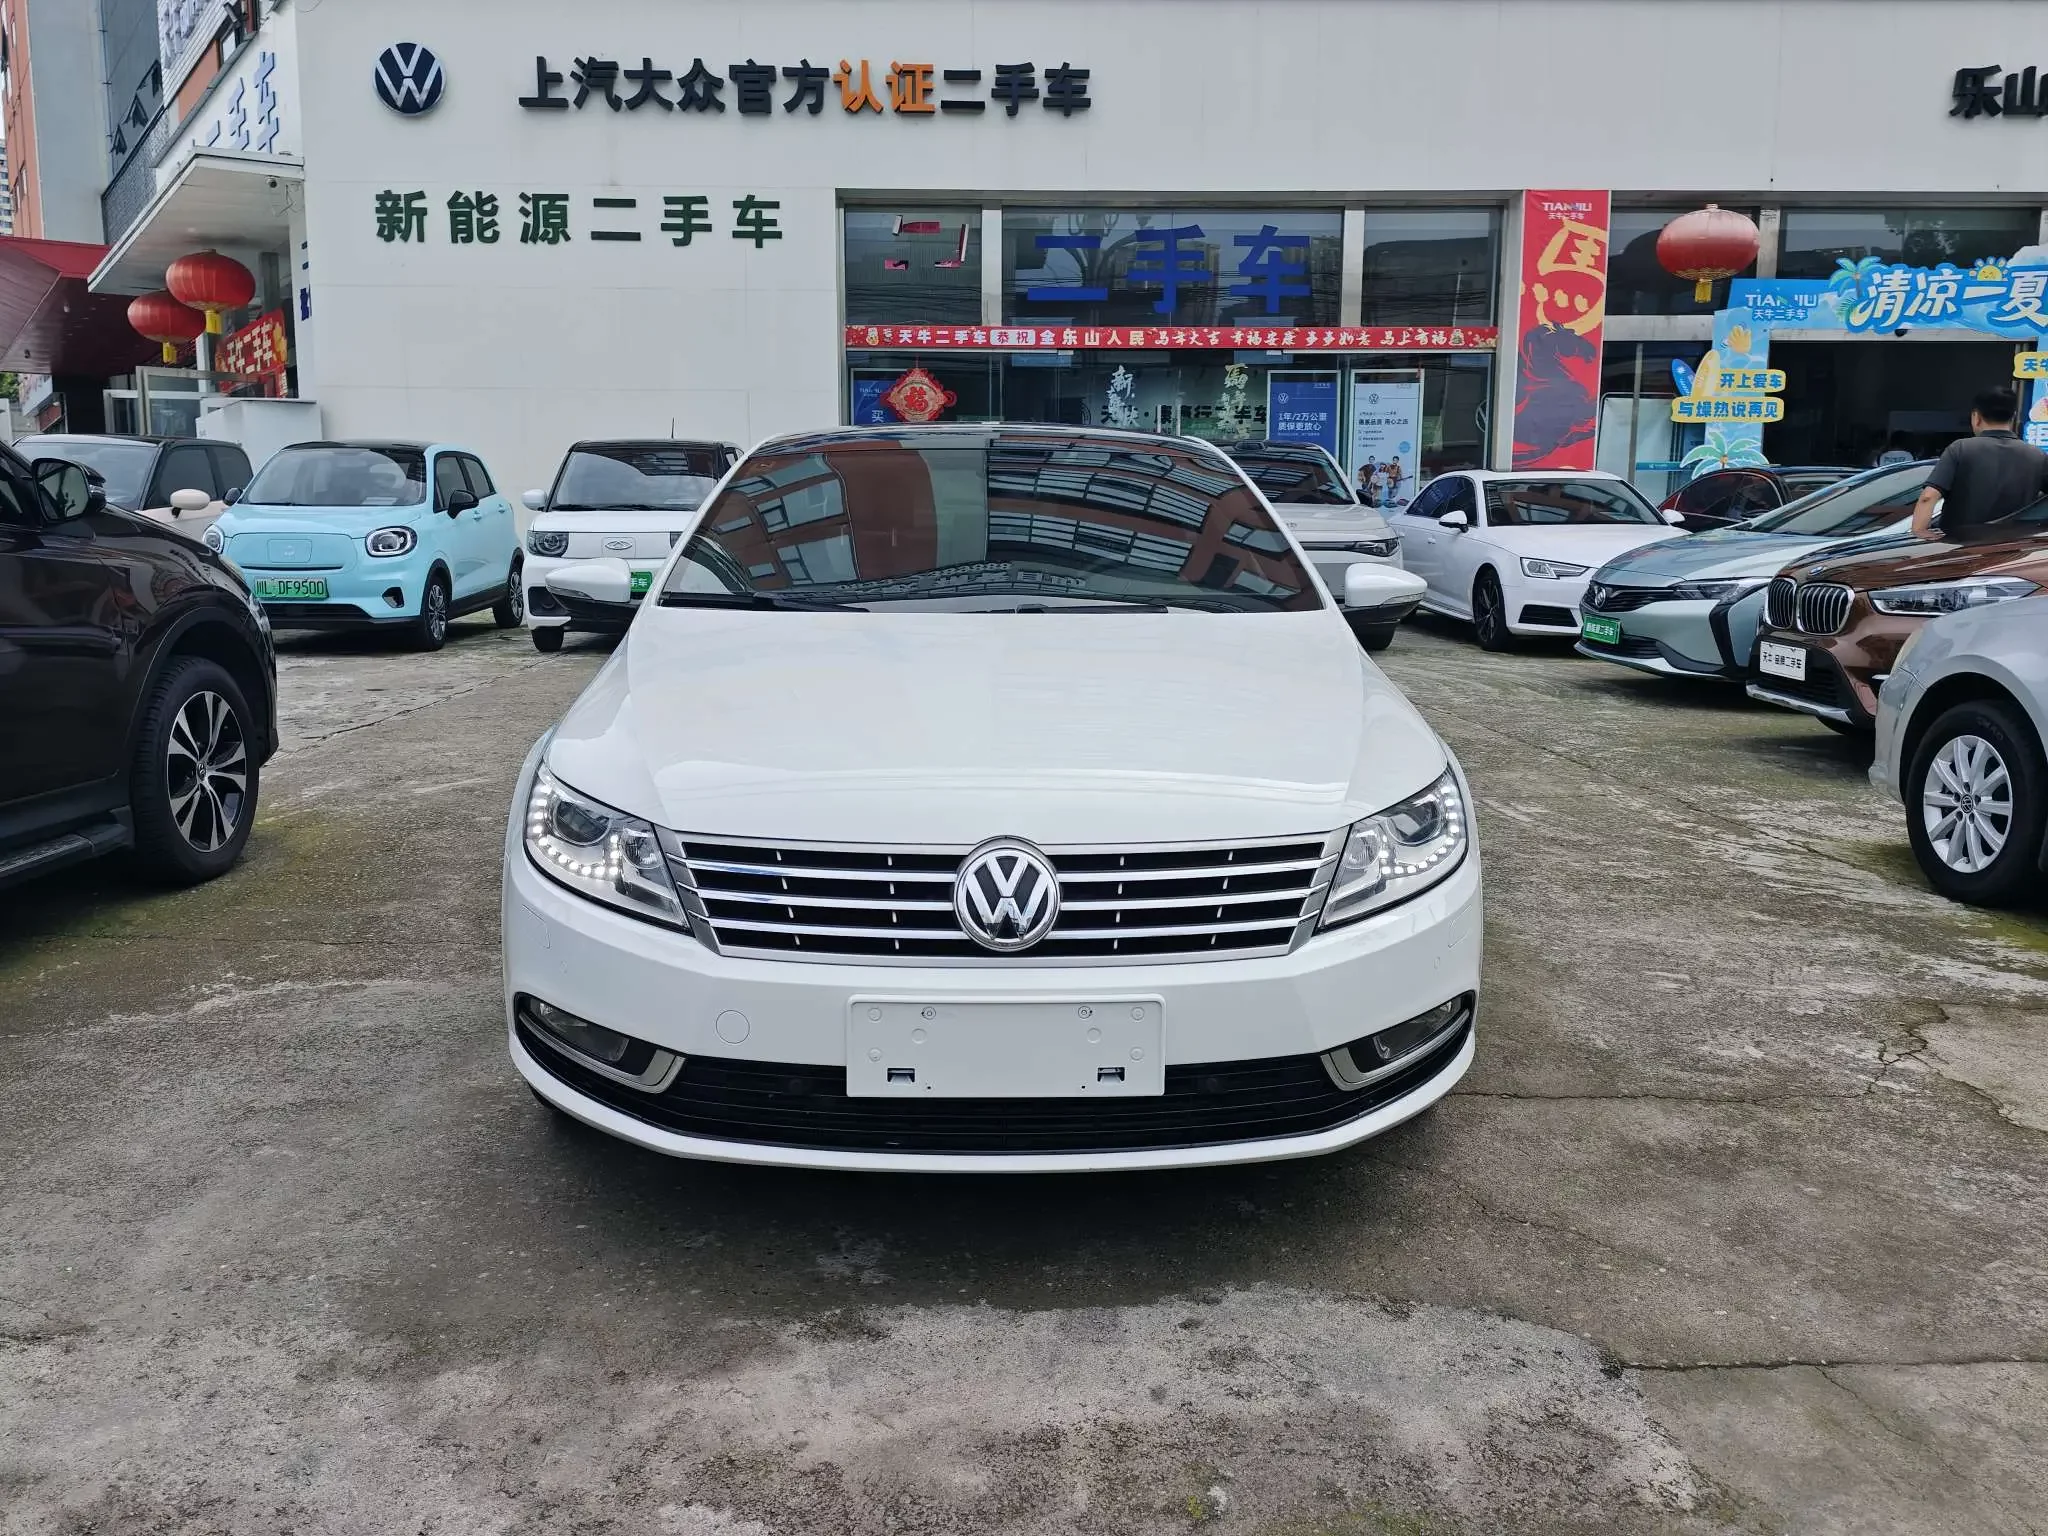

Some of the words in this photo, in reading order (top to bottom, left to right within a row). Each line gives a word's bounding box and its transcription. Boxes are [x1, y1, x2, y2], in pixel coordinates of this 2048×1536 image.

[518, 55, 1092, 118] 上汽大众官方认证二手车
[1950, 65, 2048, 118] 乐山
[375, 190, 783, 248] 新能源二手车
[1027, 224, 1312, 313] 二手车
[1849, 267, 2048, 328] 清凉一夏
[1753, 308, 1807, 320] 天牛二手车
[997, 330, 1029, 345] 恭祝
[1039, 328, 1145, 346] 全乐山人民
[1720, 373, 1783, 389] 开上爱车
[871, 409, 884, 423] 买
[1678, 401, 1779, 418] 与燥热说再见
[1278, 422, 1321, 431] 质保更放心
[278, 580, 325, 595] DF9500
